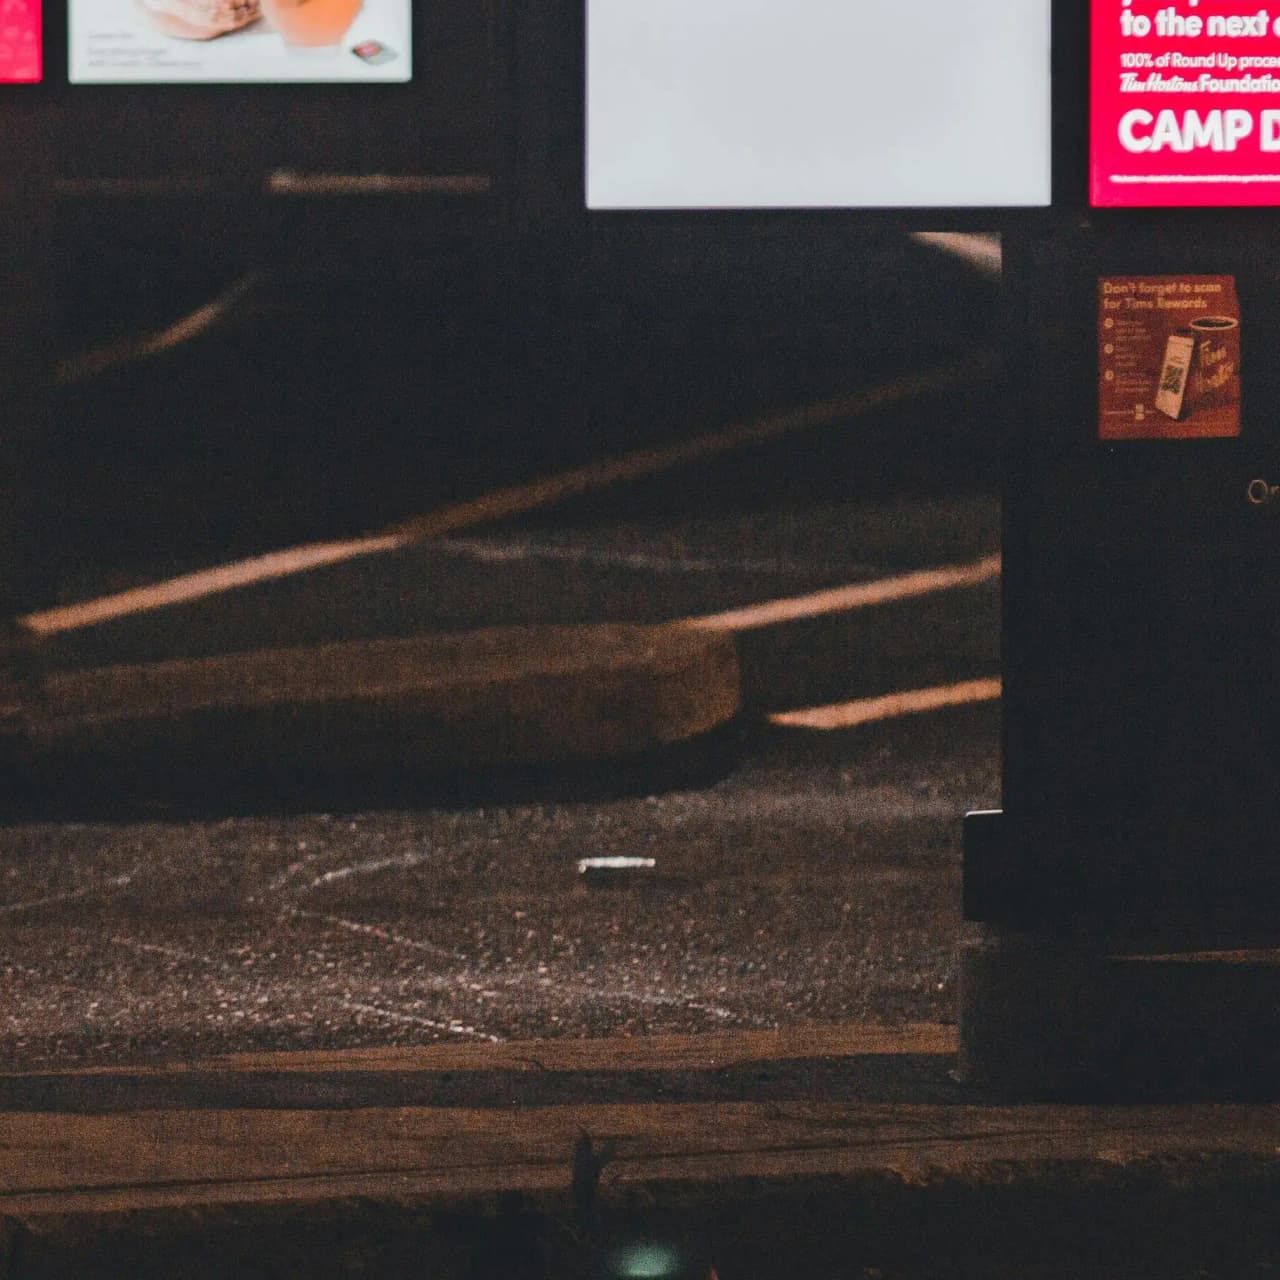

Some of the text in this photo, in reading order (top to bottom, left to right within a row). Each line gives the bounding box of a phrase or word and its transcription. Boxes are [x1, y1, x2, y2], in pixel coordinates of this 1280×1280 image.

[1120, 10, 1151, 37] to
[1155, 7, 1203, 37] the
[1207, 11, 1270, 37] next
[1120, 53, 1153, 68] 100%
[1154, 54, 1170, 68] of
[1172, 53, 1216, 68] Round
[1218, 54, 1237, 72] Up
[1118, 109, 1253, 153] CAMP
